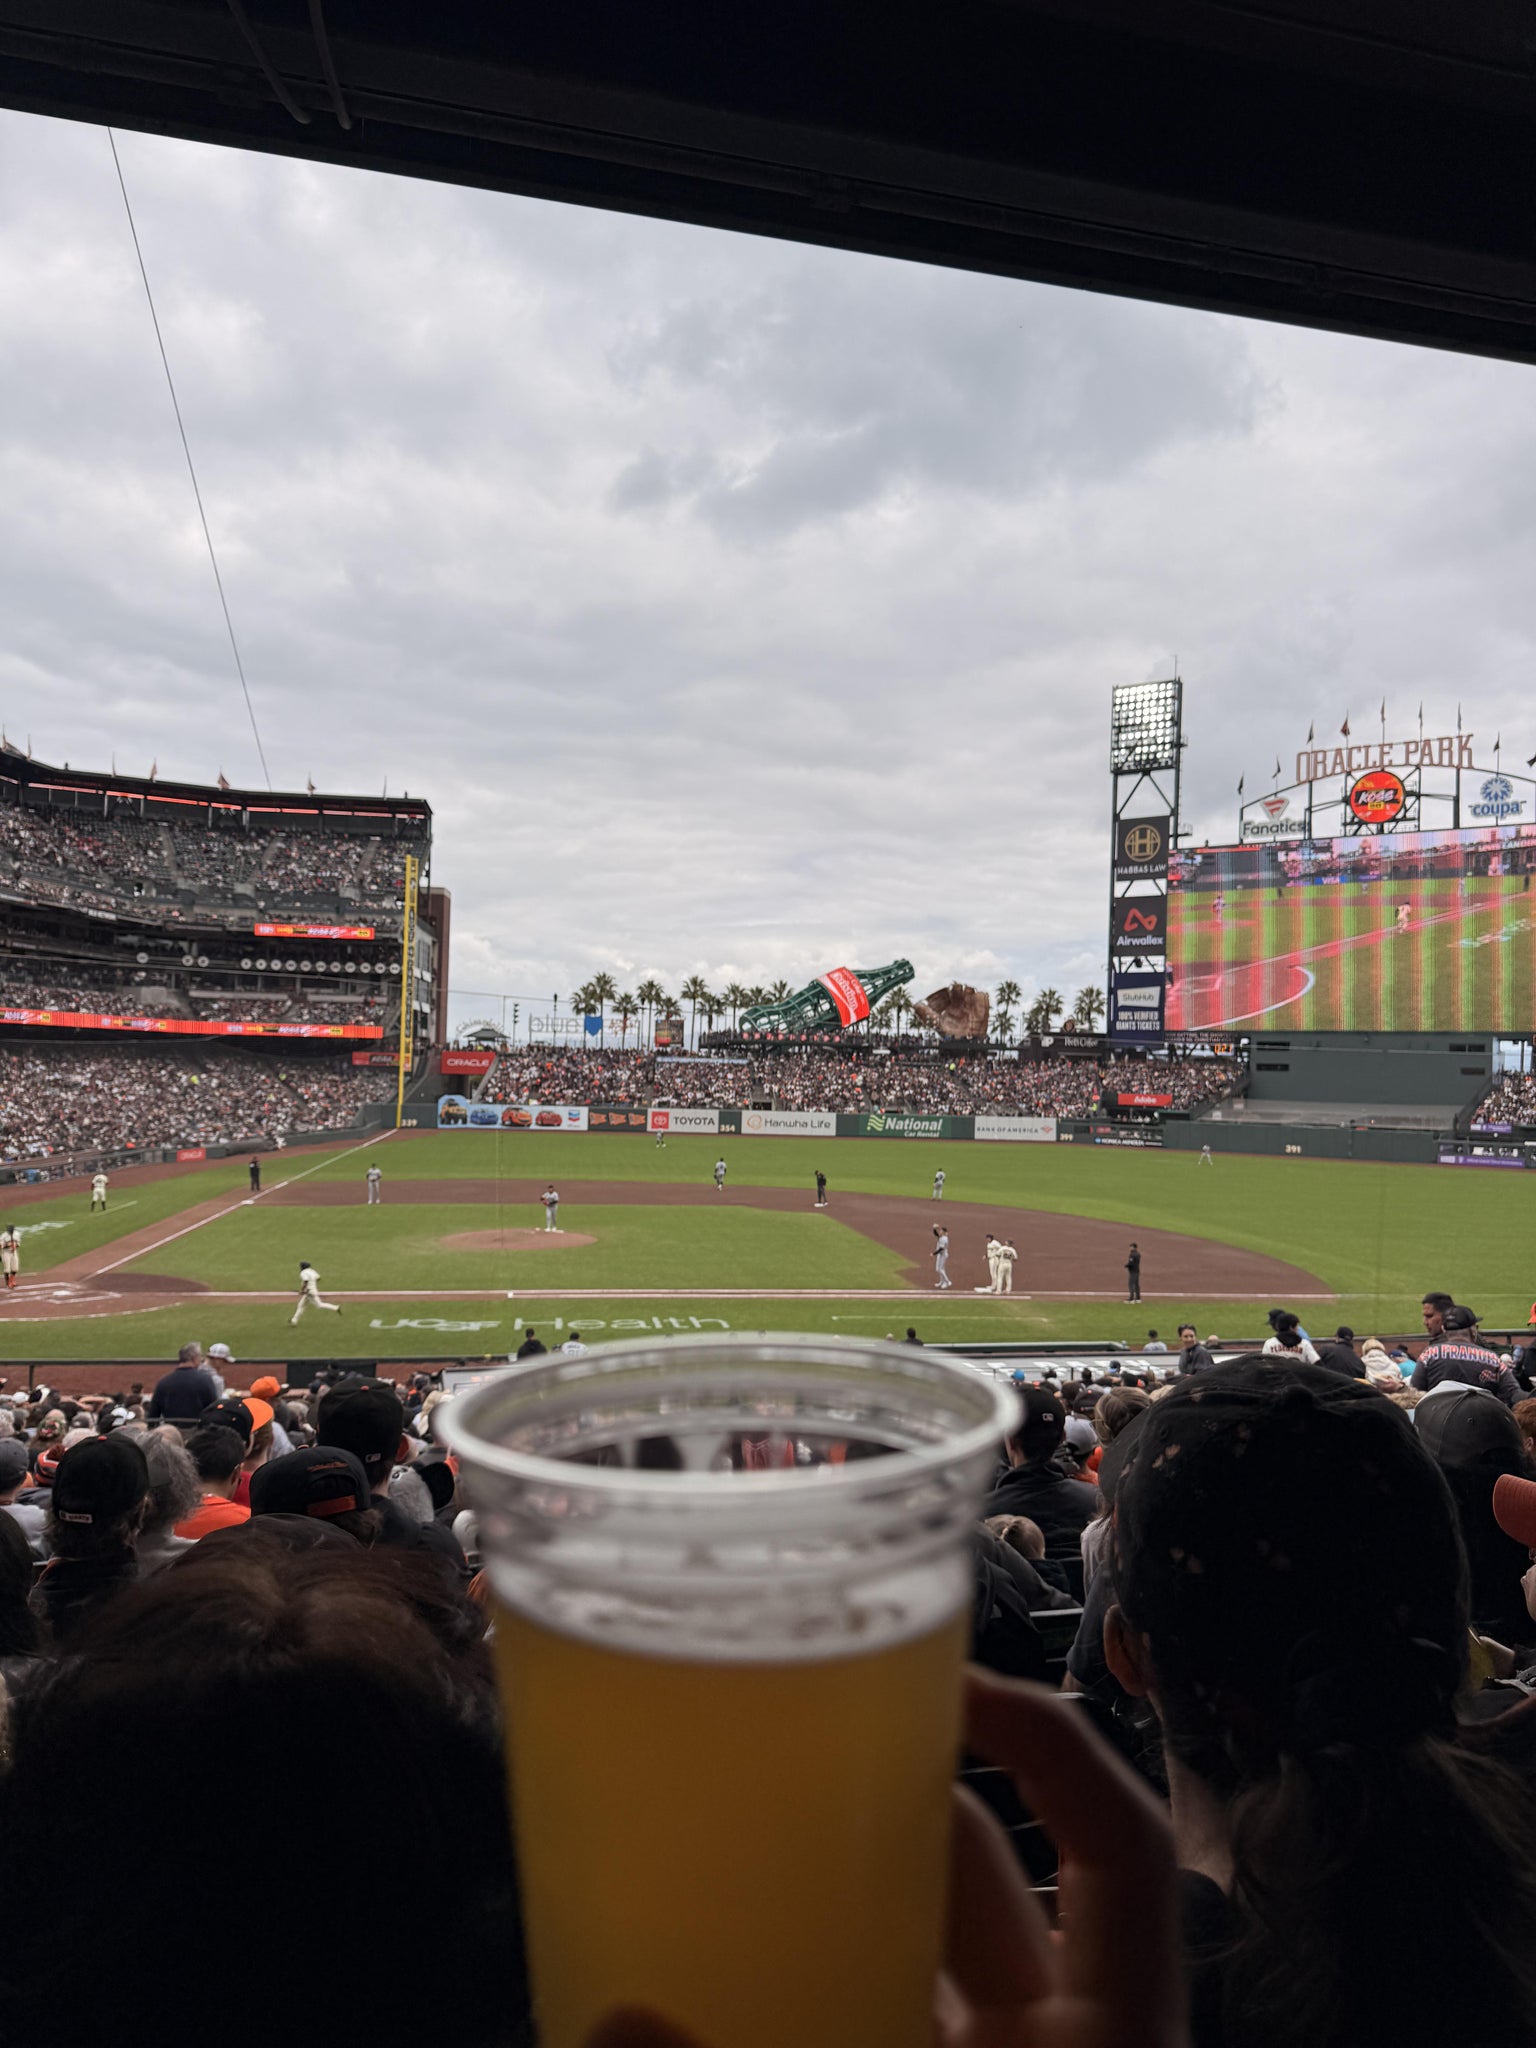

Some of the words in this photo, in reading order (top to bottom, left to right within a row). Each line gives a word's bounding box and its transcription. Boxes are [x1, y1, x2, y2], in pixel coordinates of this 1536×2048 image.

[1296, 743, 1393, 784] ORACLE
[1404, 734, 1475, 769] PARK
[1472, 801, 1520, 817] coupa
[1242, 818, 1305, 836] Fanatics
[1117, 864, 1147, 875] HABBAS
[1150, 863, 1166, 873] LAW
[1116, 935, 1164, 947] Airwallex
[1122, 992, 1154, 1002] StubHub
[1134, 1011, 1159, 1020] VERIFIED
[1115, 1021, 1136, 1030] GIANTS
[1137, 1021, 1160, 1031] TICKETS
[447, 1059, 490, 1067] ORACLE
[1134, 1096, 1157, 1104] Adobe
[673, 1116, 716, 1126] TOYOTA
[765, 1119, 808, 1129] Hanwha
[811, 1119, 831, 1129] Life
[886, 1117, 944, 1131] National
[514, 1316, 731, 1331] Health
